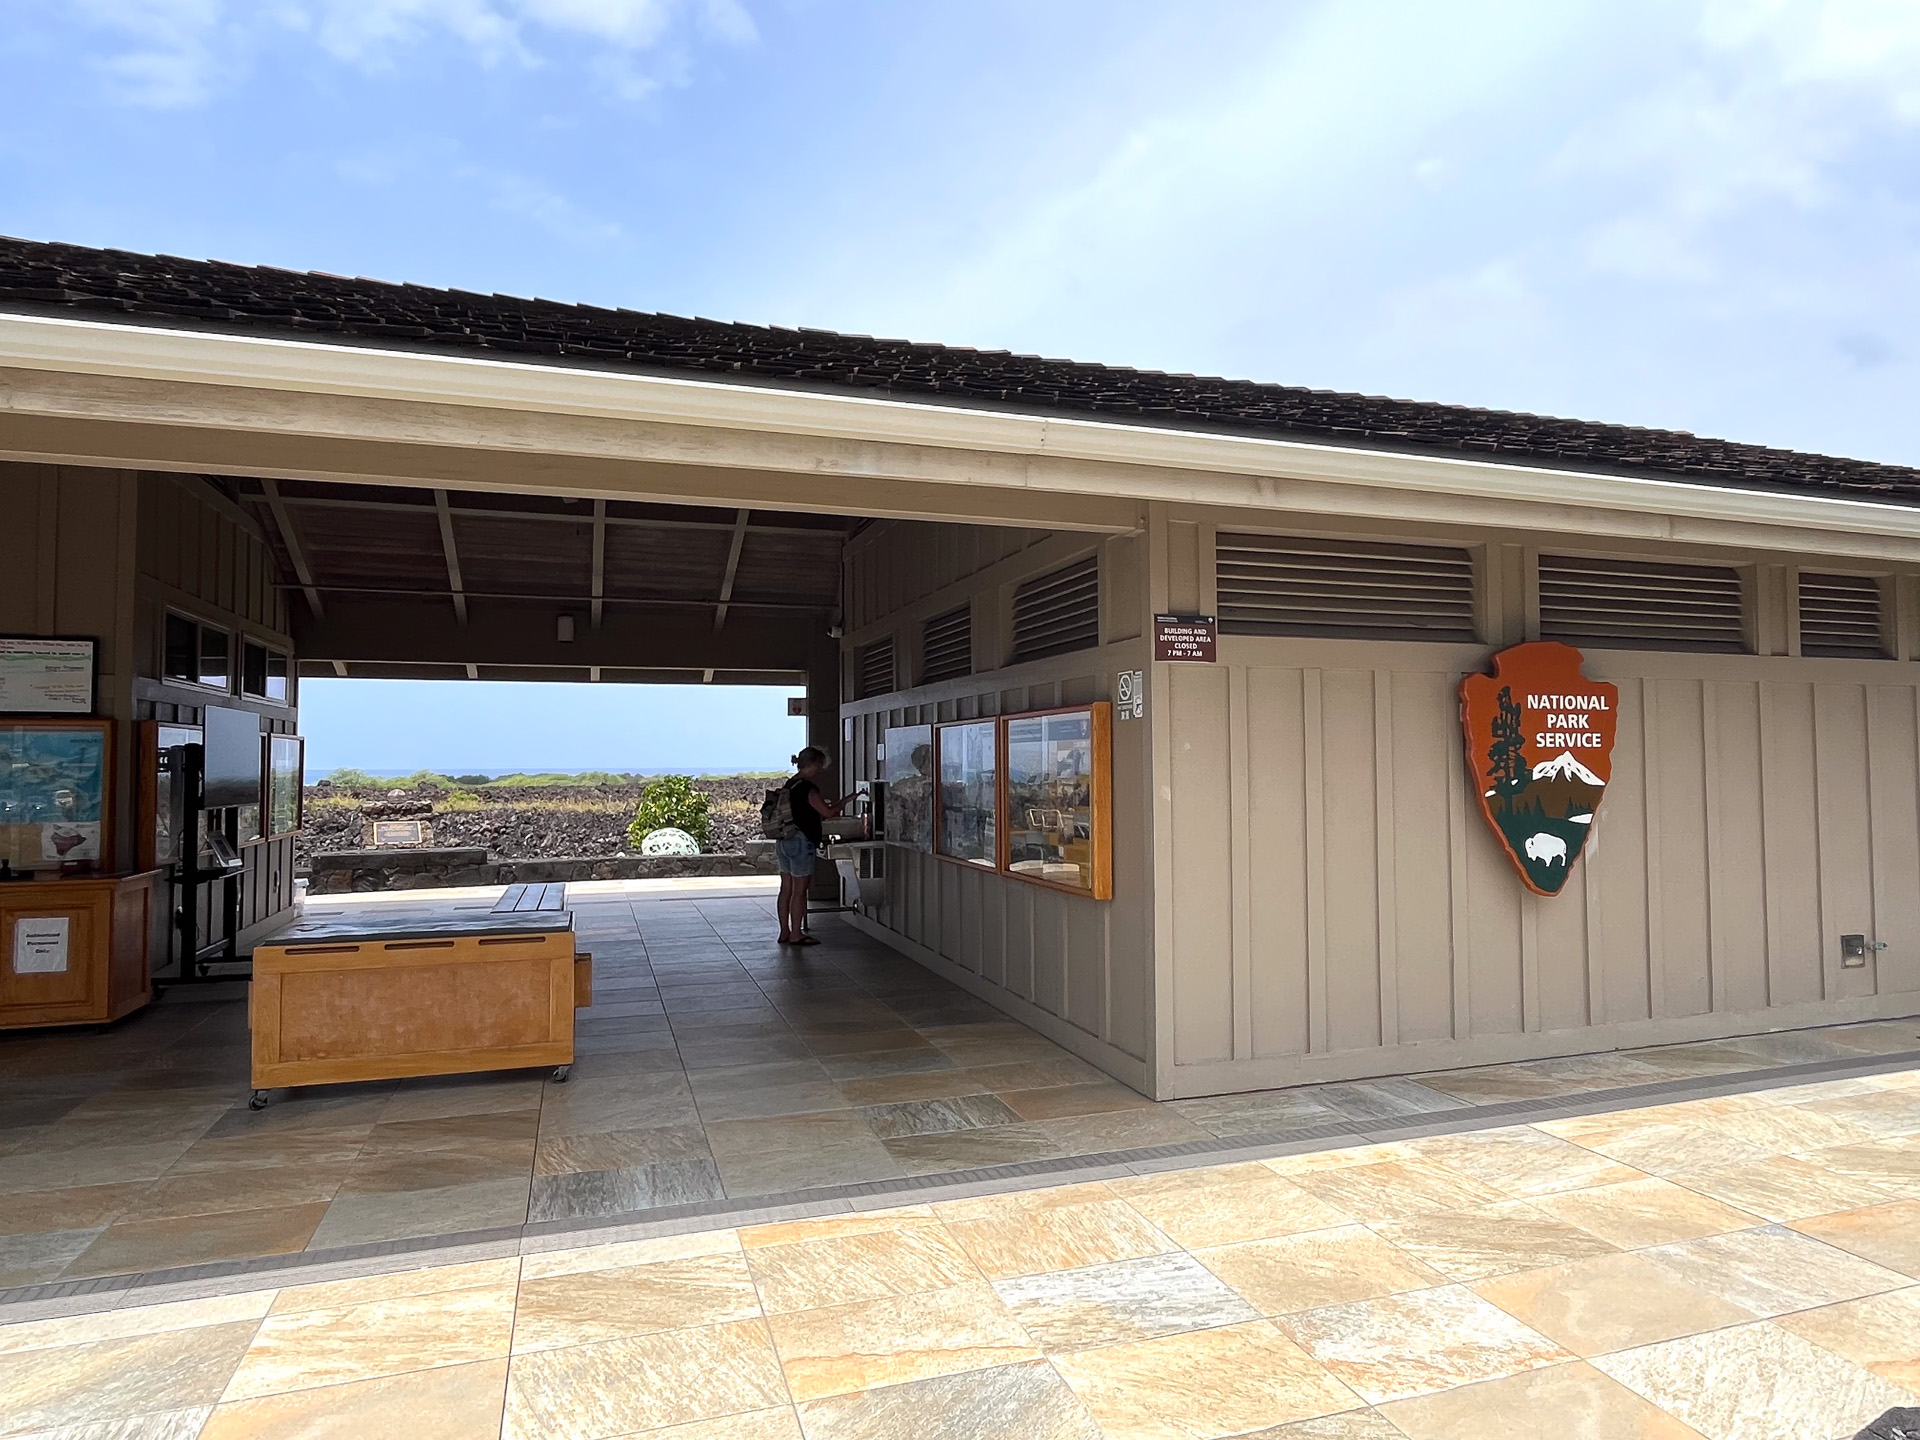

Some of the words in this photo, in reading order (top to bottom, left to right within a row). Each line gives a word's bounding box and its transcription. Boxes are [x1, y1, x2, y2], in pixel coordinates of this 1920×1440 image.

[1164, 627, 1193, 635] BUILDING
[1159, 634, 1195, 642] DEVELOPED
[1174, 642, 1198, 650] CLOSED
[1167, 649, 1172, 657] 7
[1527, 694, 1610, 711] NATIONAL
[1546, 713, 1590, 729] PARK
[1535, 732, 1602, 748] SERVICE
